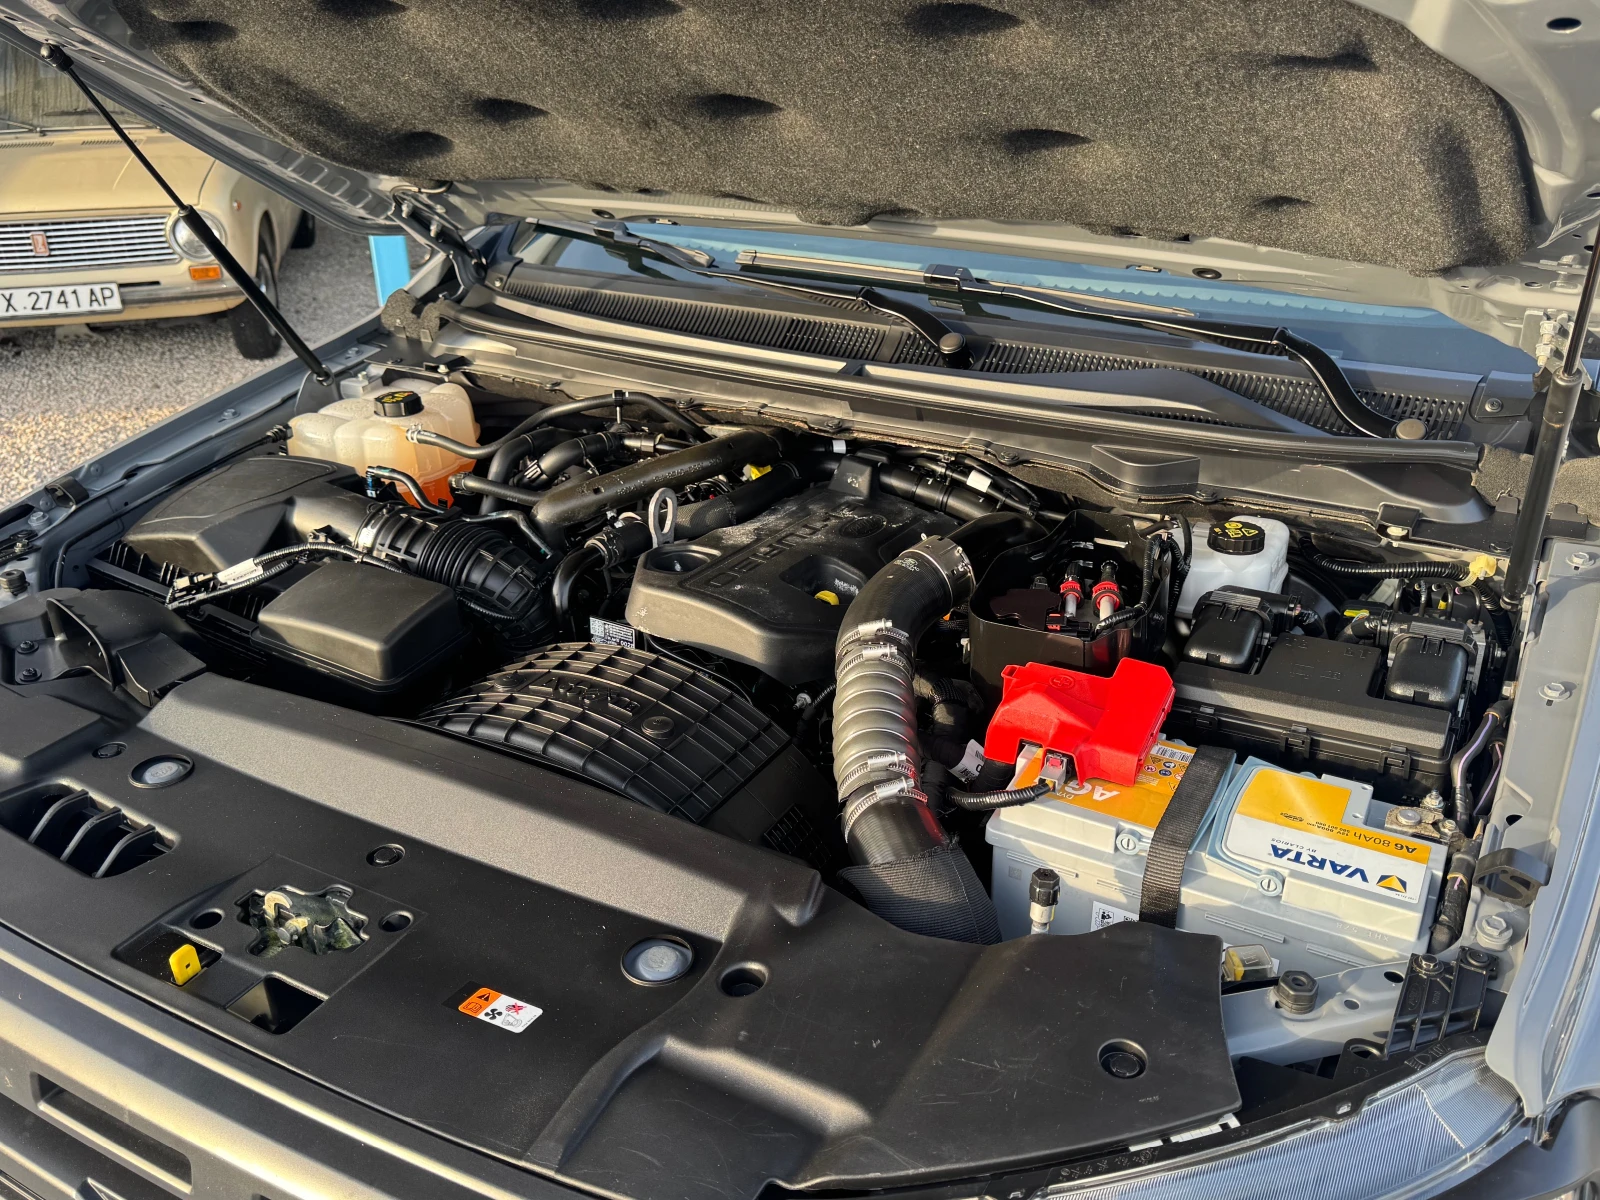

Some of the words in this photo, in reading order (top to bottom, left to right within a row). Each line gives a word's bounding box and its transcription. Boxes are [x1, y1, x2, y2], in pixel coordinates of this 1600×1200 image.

[89, 287, 114, 307] AP
[1063, 779, 1121, 802] AG
[1270, 838, 1305, 851] CLARIOS
[1353, 831, 1391, 849] 80Ah
[1394, 842, 1418, 854] A6
[1270, 843, 1370, 884] VARTA
